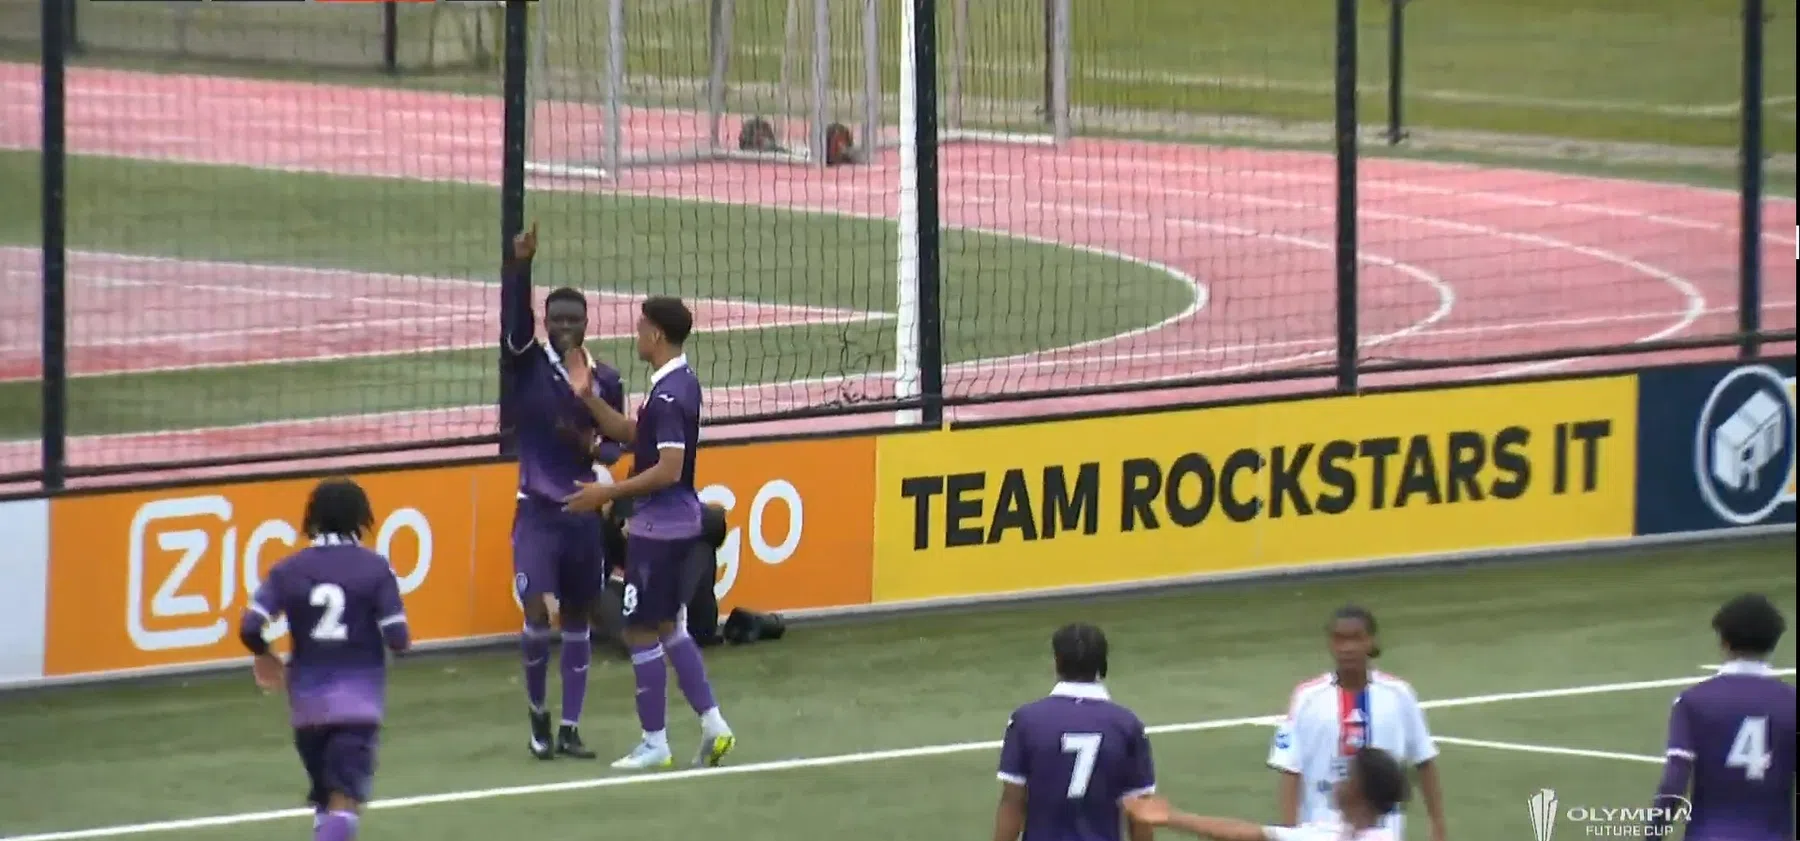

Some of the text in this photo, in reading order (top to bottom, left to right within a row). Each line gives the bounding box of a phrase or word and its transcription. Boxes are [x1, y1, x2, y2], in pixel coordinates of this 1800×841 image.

[901, 461, 1100, 551] TEAM
[1121, 425, 1532, 533] ROCKSTARS
[1552, 419, 1613, 495] IT
[309, 582, 349, 640] 2
[1060, 731, 1103, 799] 7
[1724, 715, 1775, 781] 4
